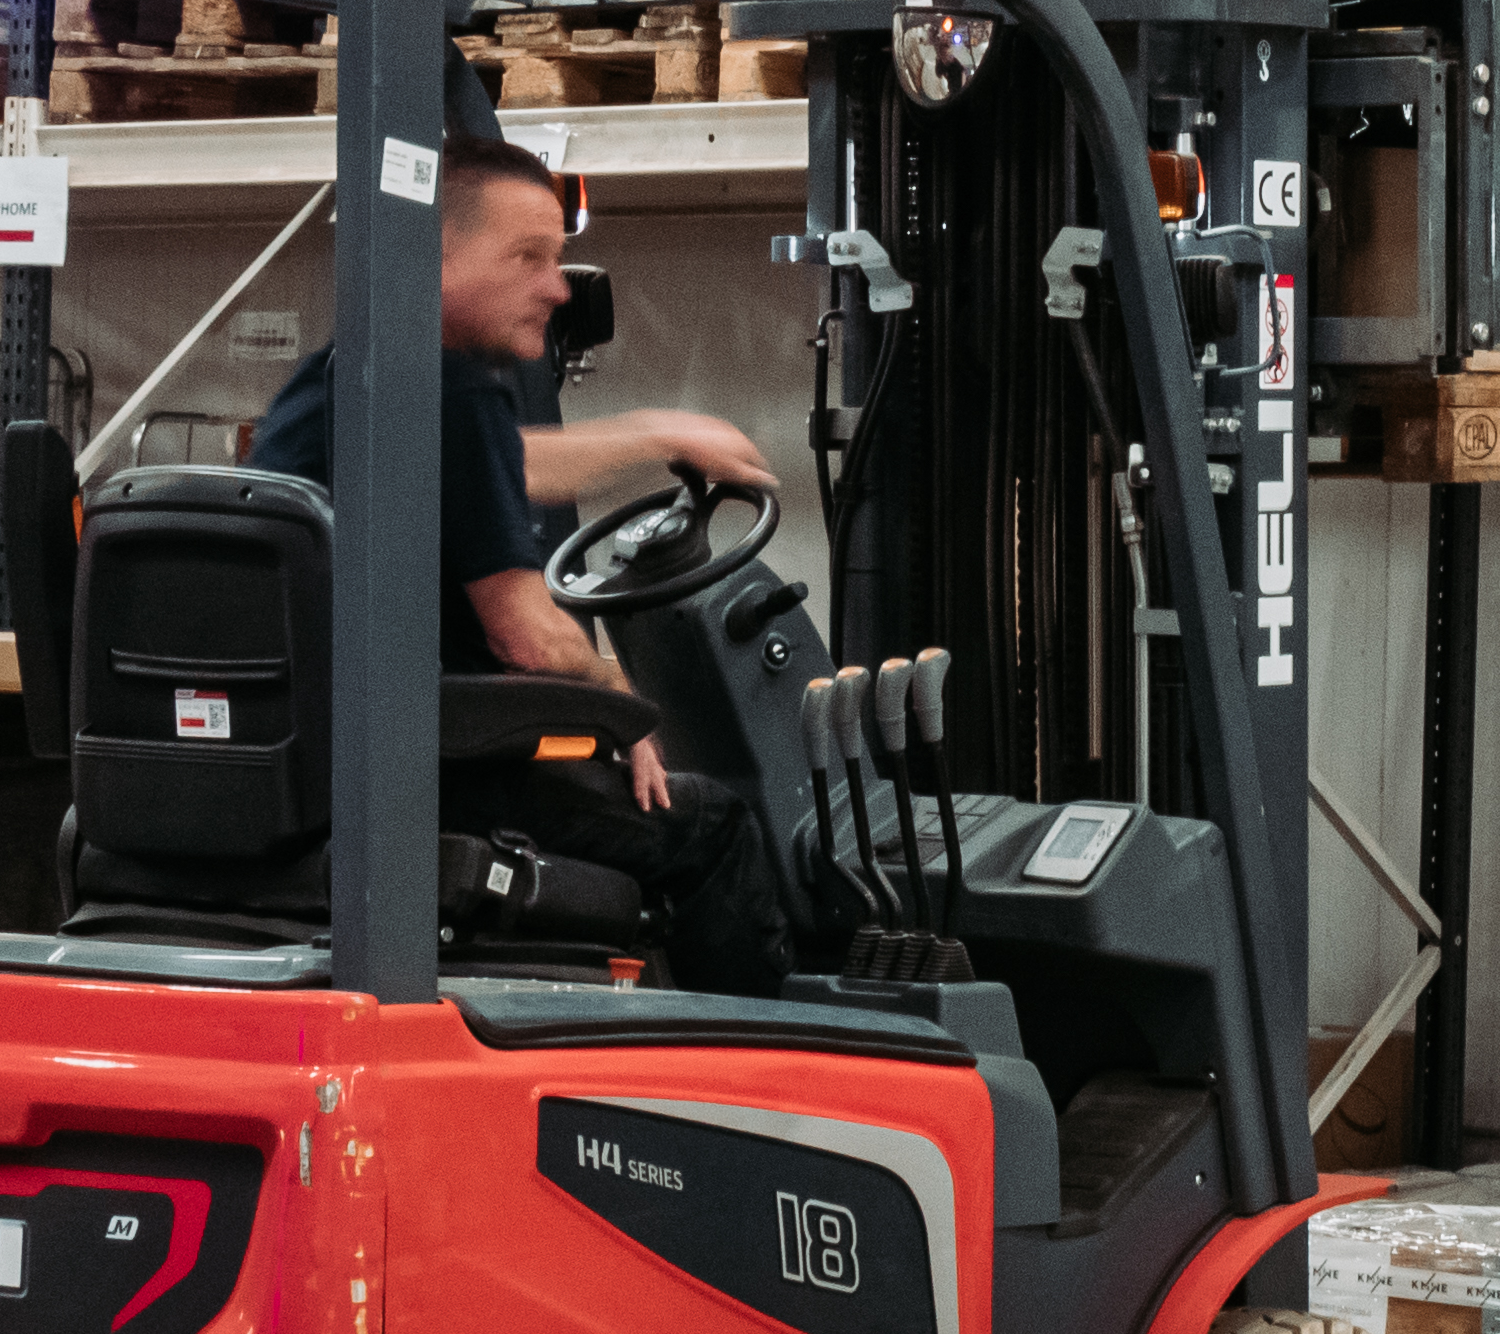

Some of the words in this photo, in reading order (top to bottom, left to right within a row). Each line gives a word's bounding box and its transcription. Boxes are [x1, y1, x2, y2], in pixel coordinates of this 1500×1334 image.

[1257, 399, 1294, 687] HELI
[577, 1134, 621, 1175] H4
[628, 1159, 684, 1192] SERIES
[776, 1191, 860, 1294] 18
